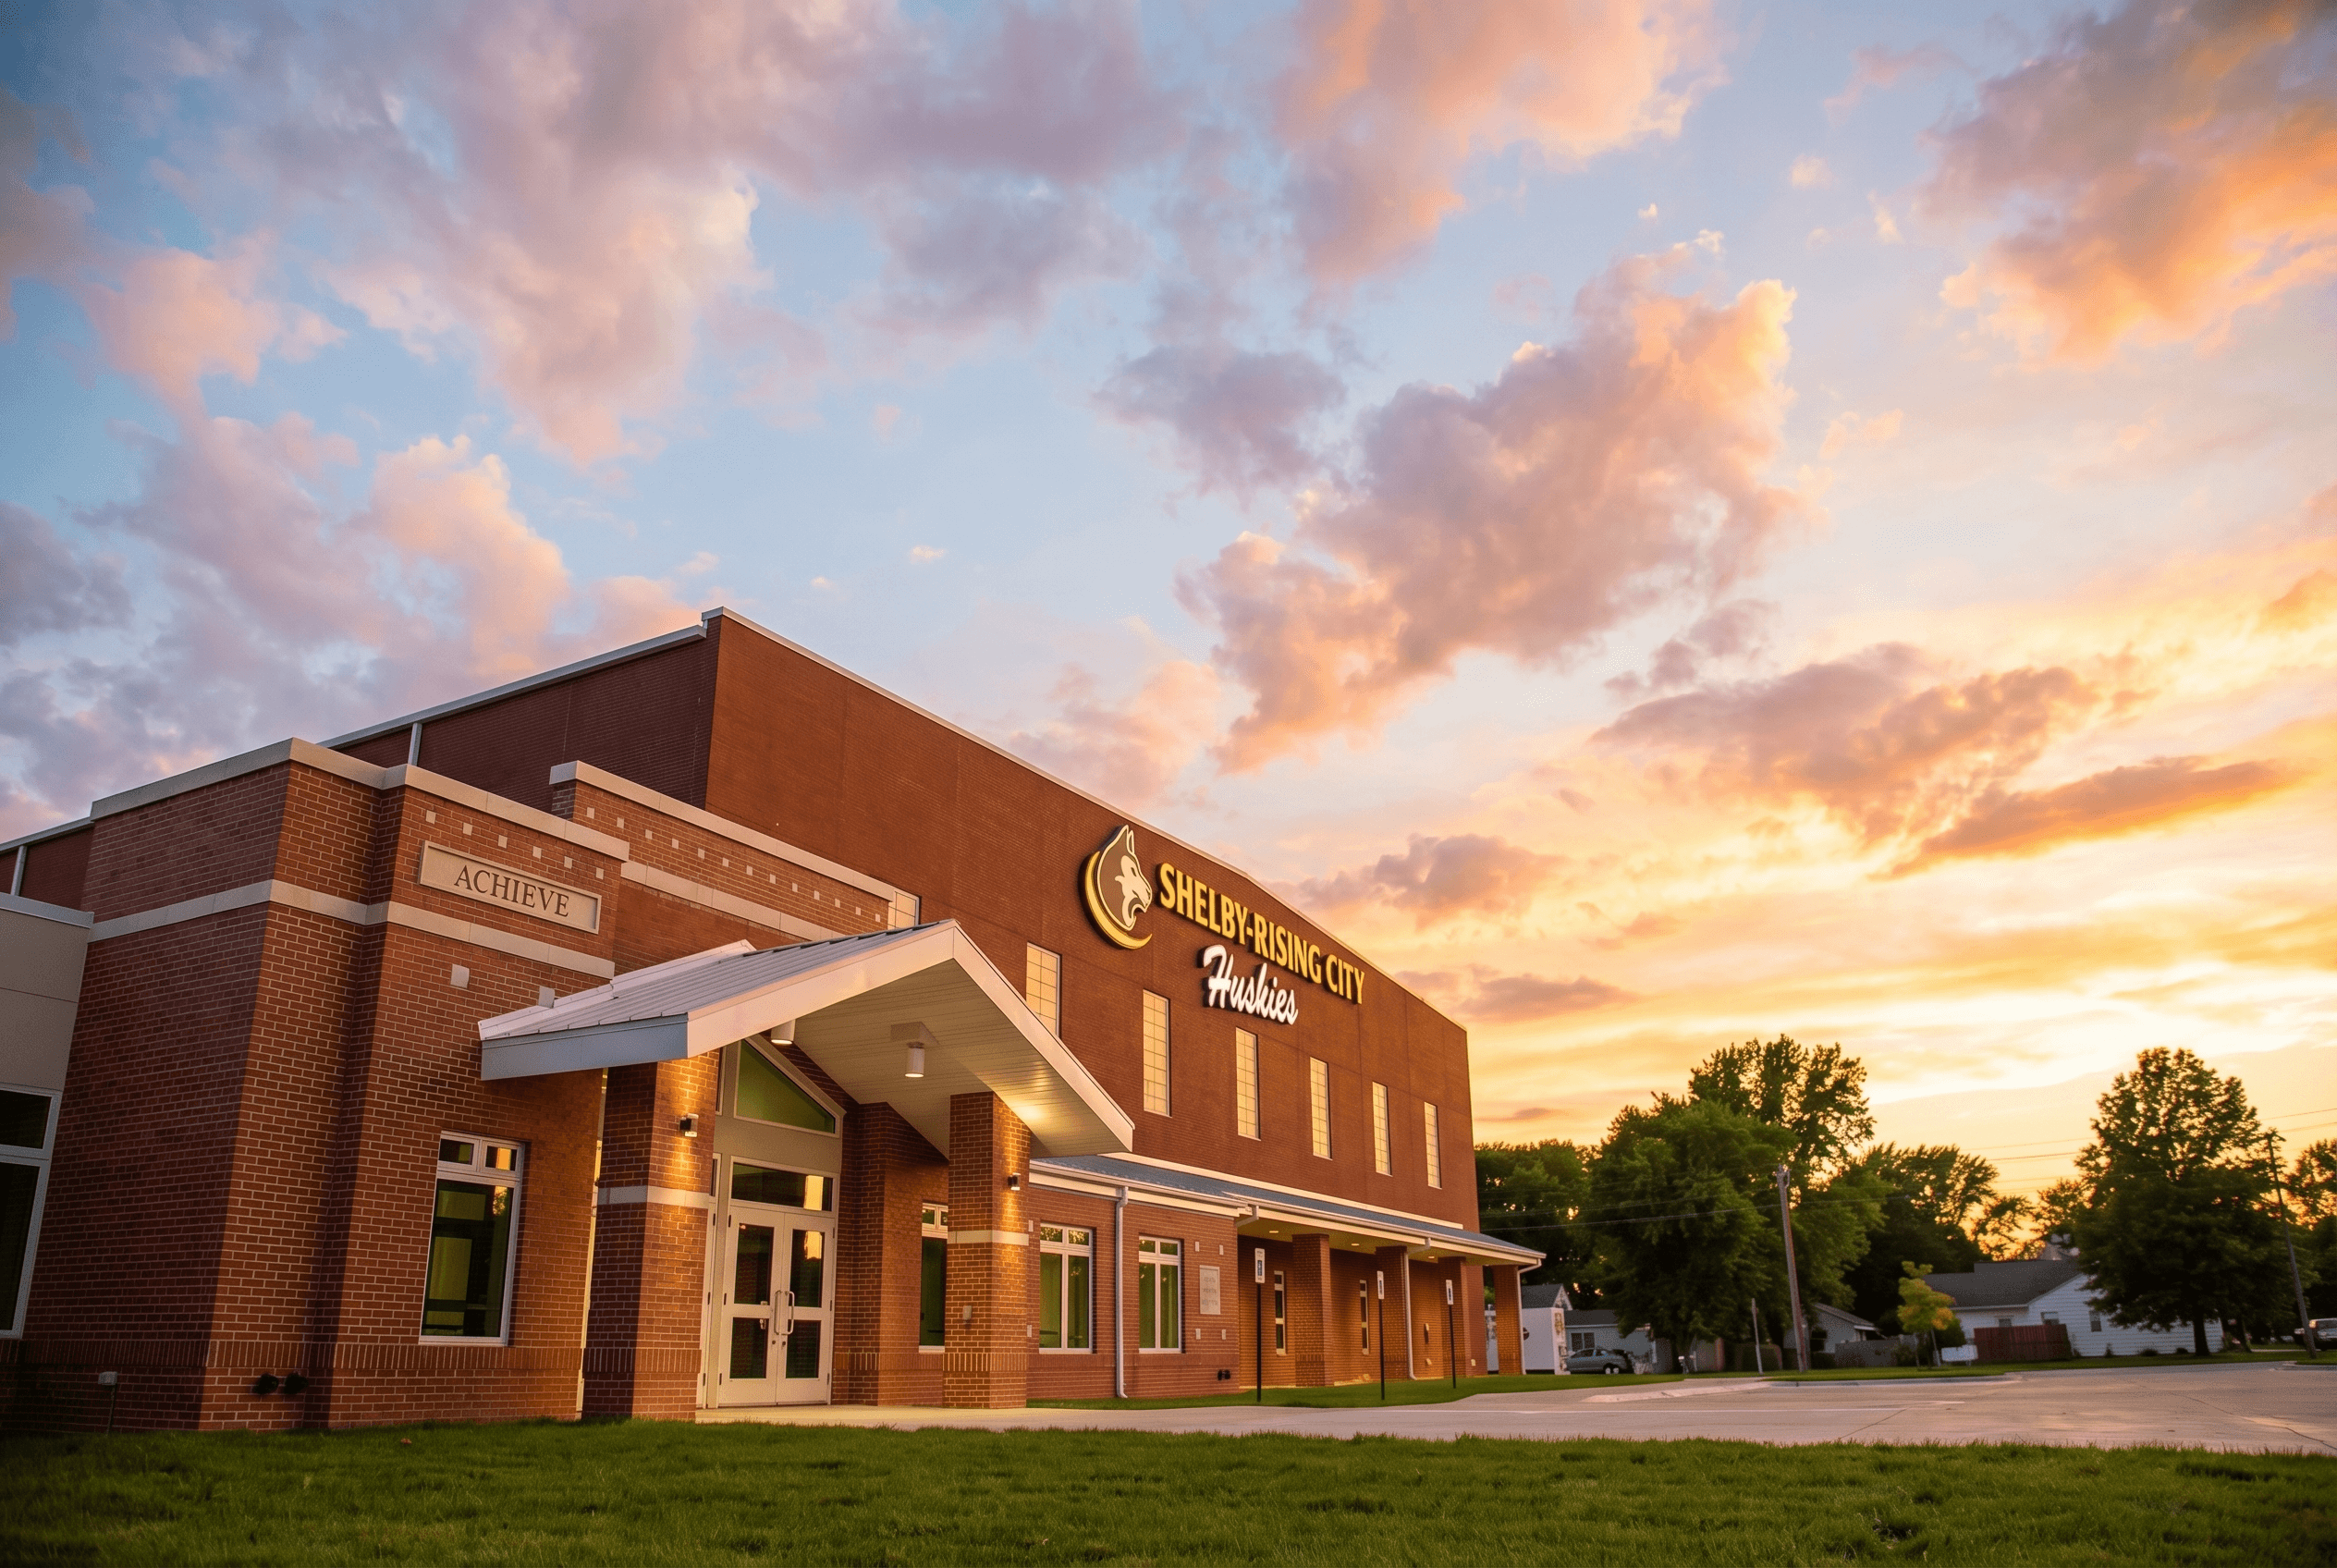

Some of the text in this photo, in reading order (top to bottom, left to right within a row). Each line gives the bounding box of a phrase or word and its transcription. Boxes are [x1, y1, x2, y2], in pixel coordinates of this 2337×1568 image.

[454, 865, 569, 917] ACHIEVE
[1159, 863, 1364, 1004] SHELBY-RISING CITY
[1204, 944, 1298, 1025] Huskies
